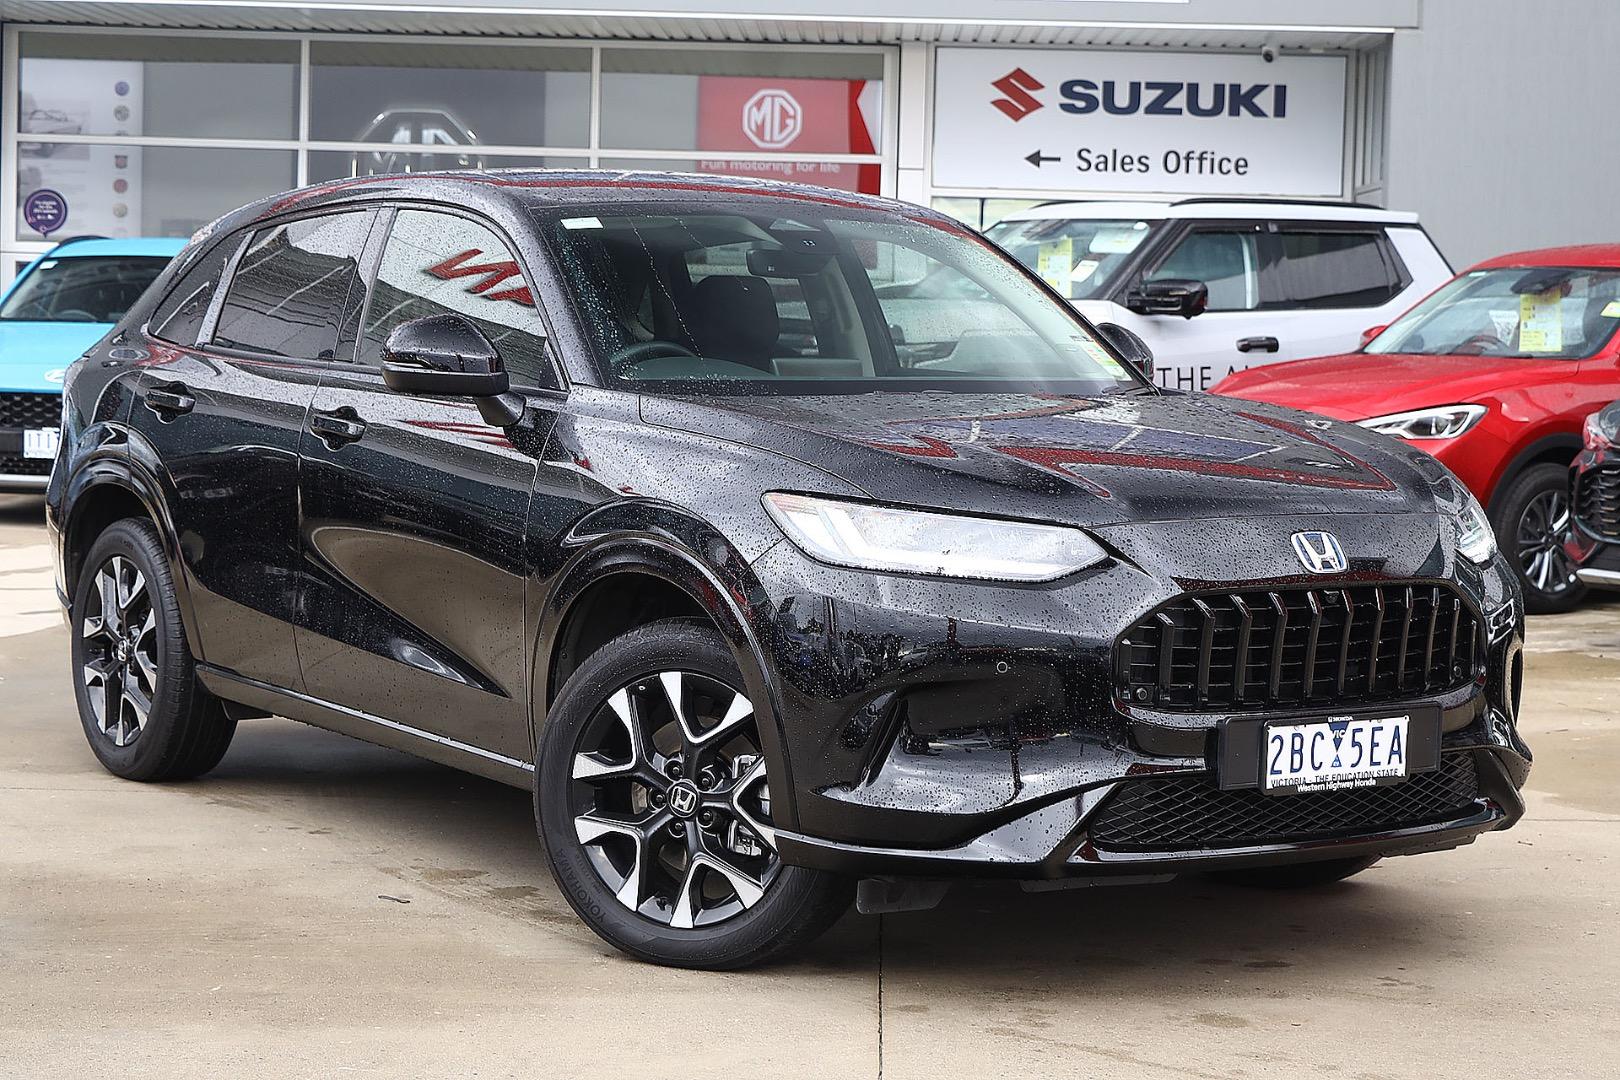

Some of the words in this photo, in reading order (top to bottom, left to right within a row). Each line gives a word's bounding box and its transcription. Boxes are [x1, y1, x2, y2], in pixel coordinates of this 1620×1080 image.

[1058, 79, 1288, 119] SUZUKI
[750, 95, 796, 142] MG
[730, 160, 792, 175] motoring
[1076, 148, 1151, 173] Sales
[1163, 150, 1249, 176] Office
[1157, 366, 1212, 391] THE
[1269, 731, 1325, 775] 2BC
[1350, 725, 1403, 768] 5EA
[1297, 782, 1326, 793] Western
[1325, 780, 1354, 792] Highway
[1354, 777, 1377, 788] Honda
